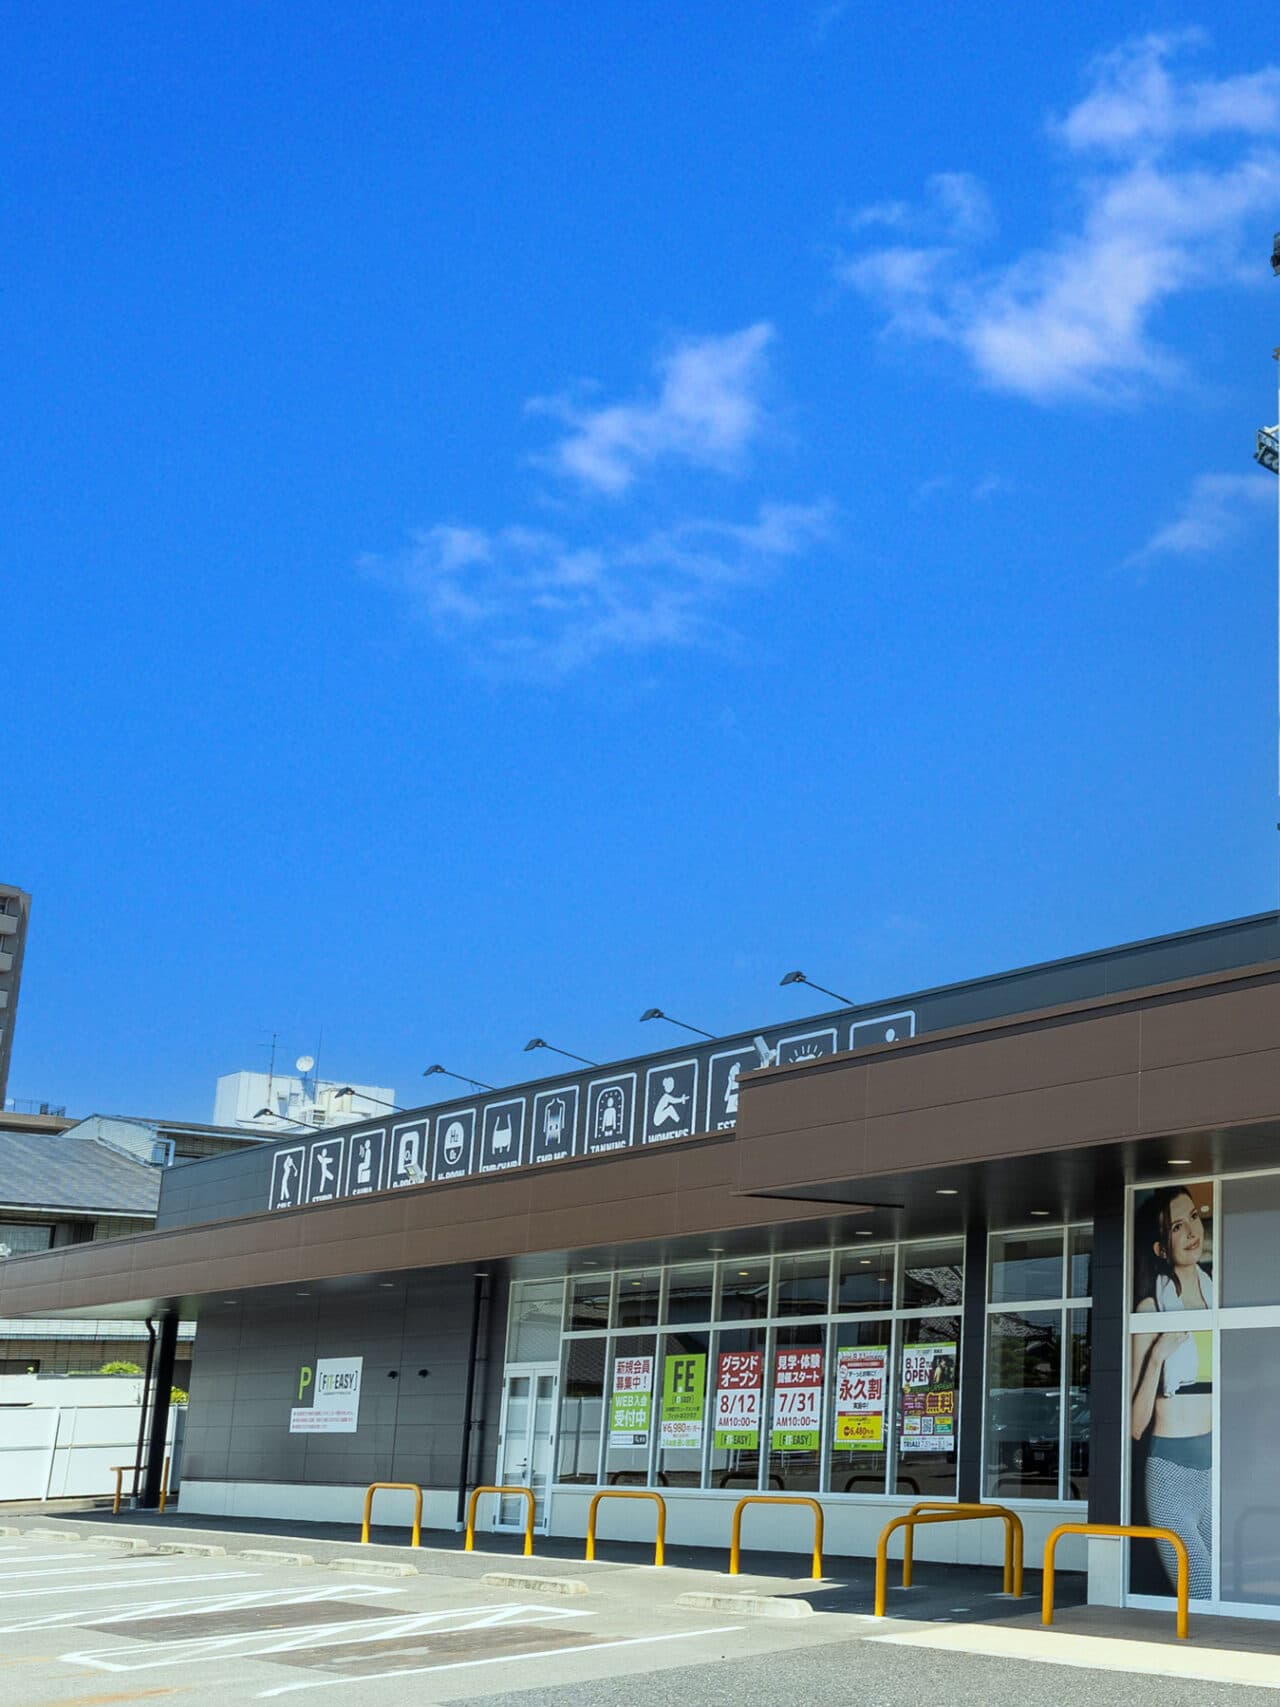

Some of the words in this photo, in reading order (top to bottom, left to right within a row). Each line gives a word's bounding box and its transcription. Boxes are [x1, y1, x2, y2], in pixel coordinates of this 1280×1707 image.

[617, 1360, 650, 1374] 新規会員
[722, 1355, 759, 1371] グランド
[777, 1354, 820, 1370] 見学・体験
[905, 1357, 926, 1369] 8.12
[298, 1366, 312, 1400] P
[721, 1371, 758, 1388] オープン
[905, 1369, 932, 1383] OPEN
[839, 1378, 882, 1401] 永久割
[720, 1394, 756, 1414] 8/12
[779, 1392, 815, 1413] 7/31
[614, 1408, 647, 1428] 受付中
